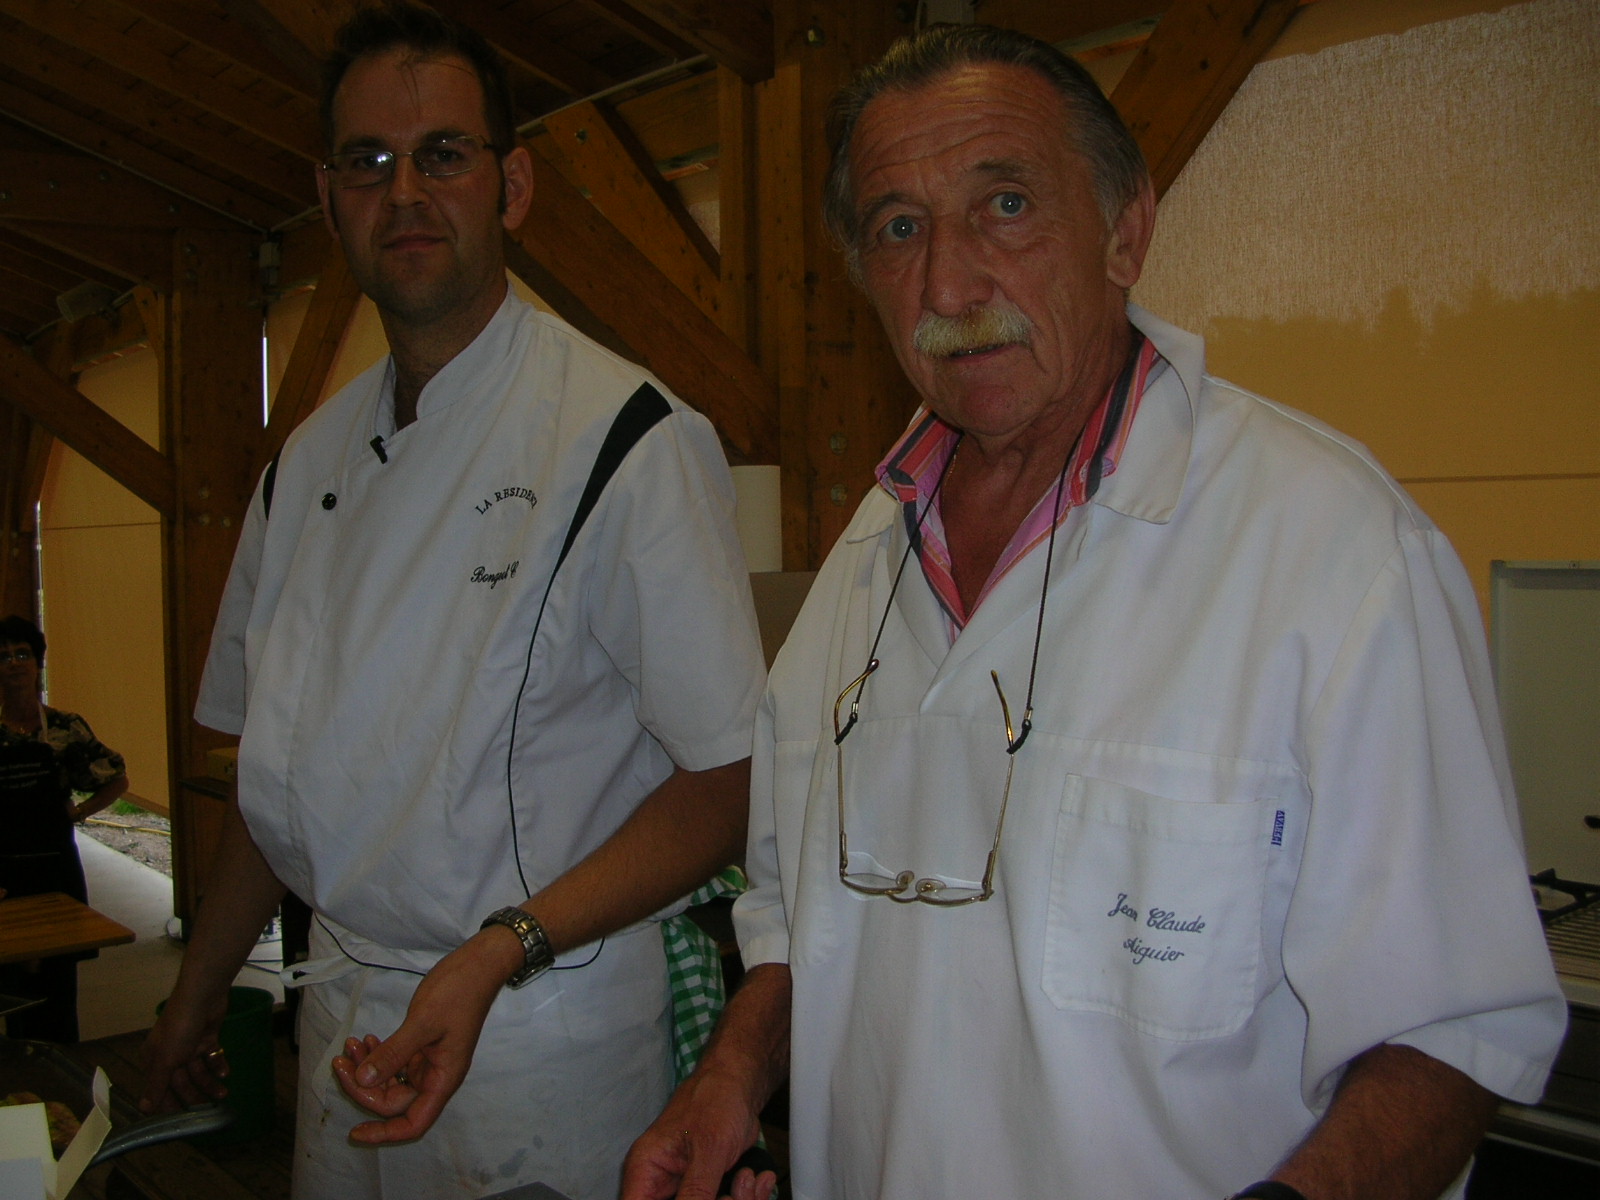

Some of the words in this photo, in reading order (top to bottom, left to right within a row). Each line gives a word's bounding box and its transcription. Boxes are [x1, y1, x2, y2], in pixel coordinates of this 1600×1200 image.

[475, 499, 493, 515] LA
[1107, 892, 1138, 922] Jean
[1146, 908, 1206, 934] Claude
[1122, 937, 1185, 965] Aiguier
